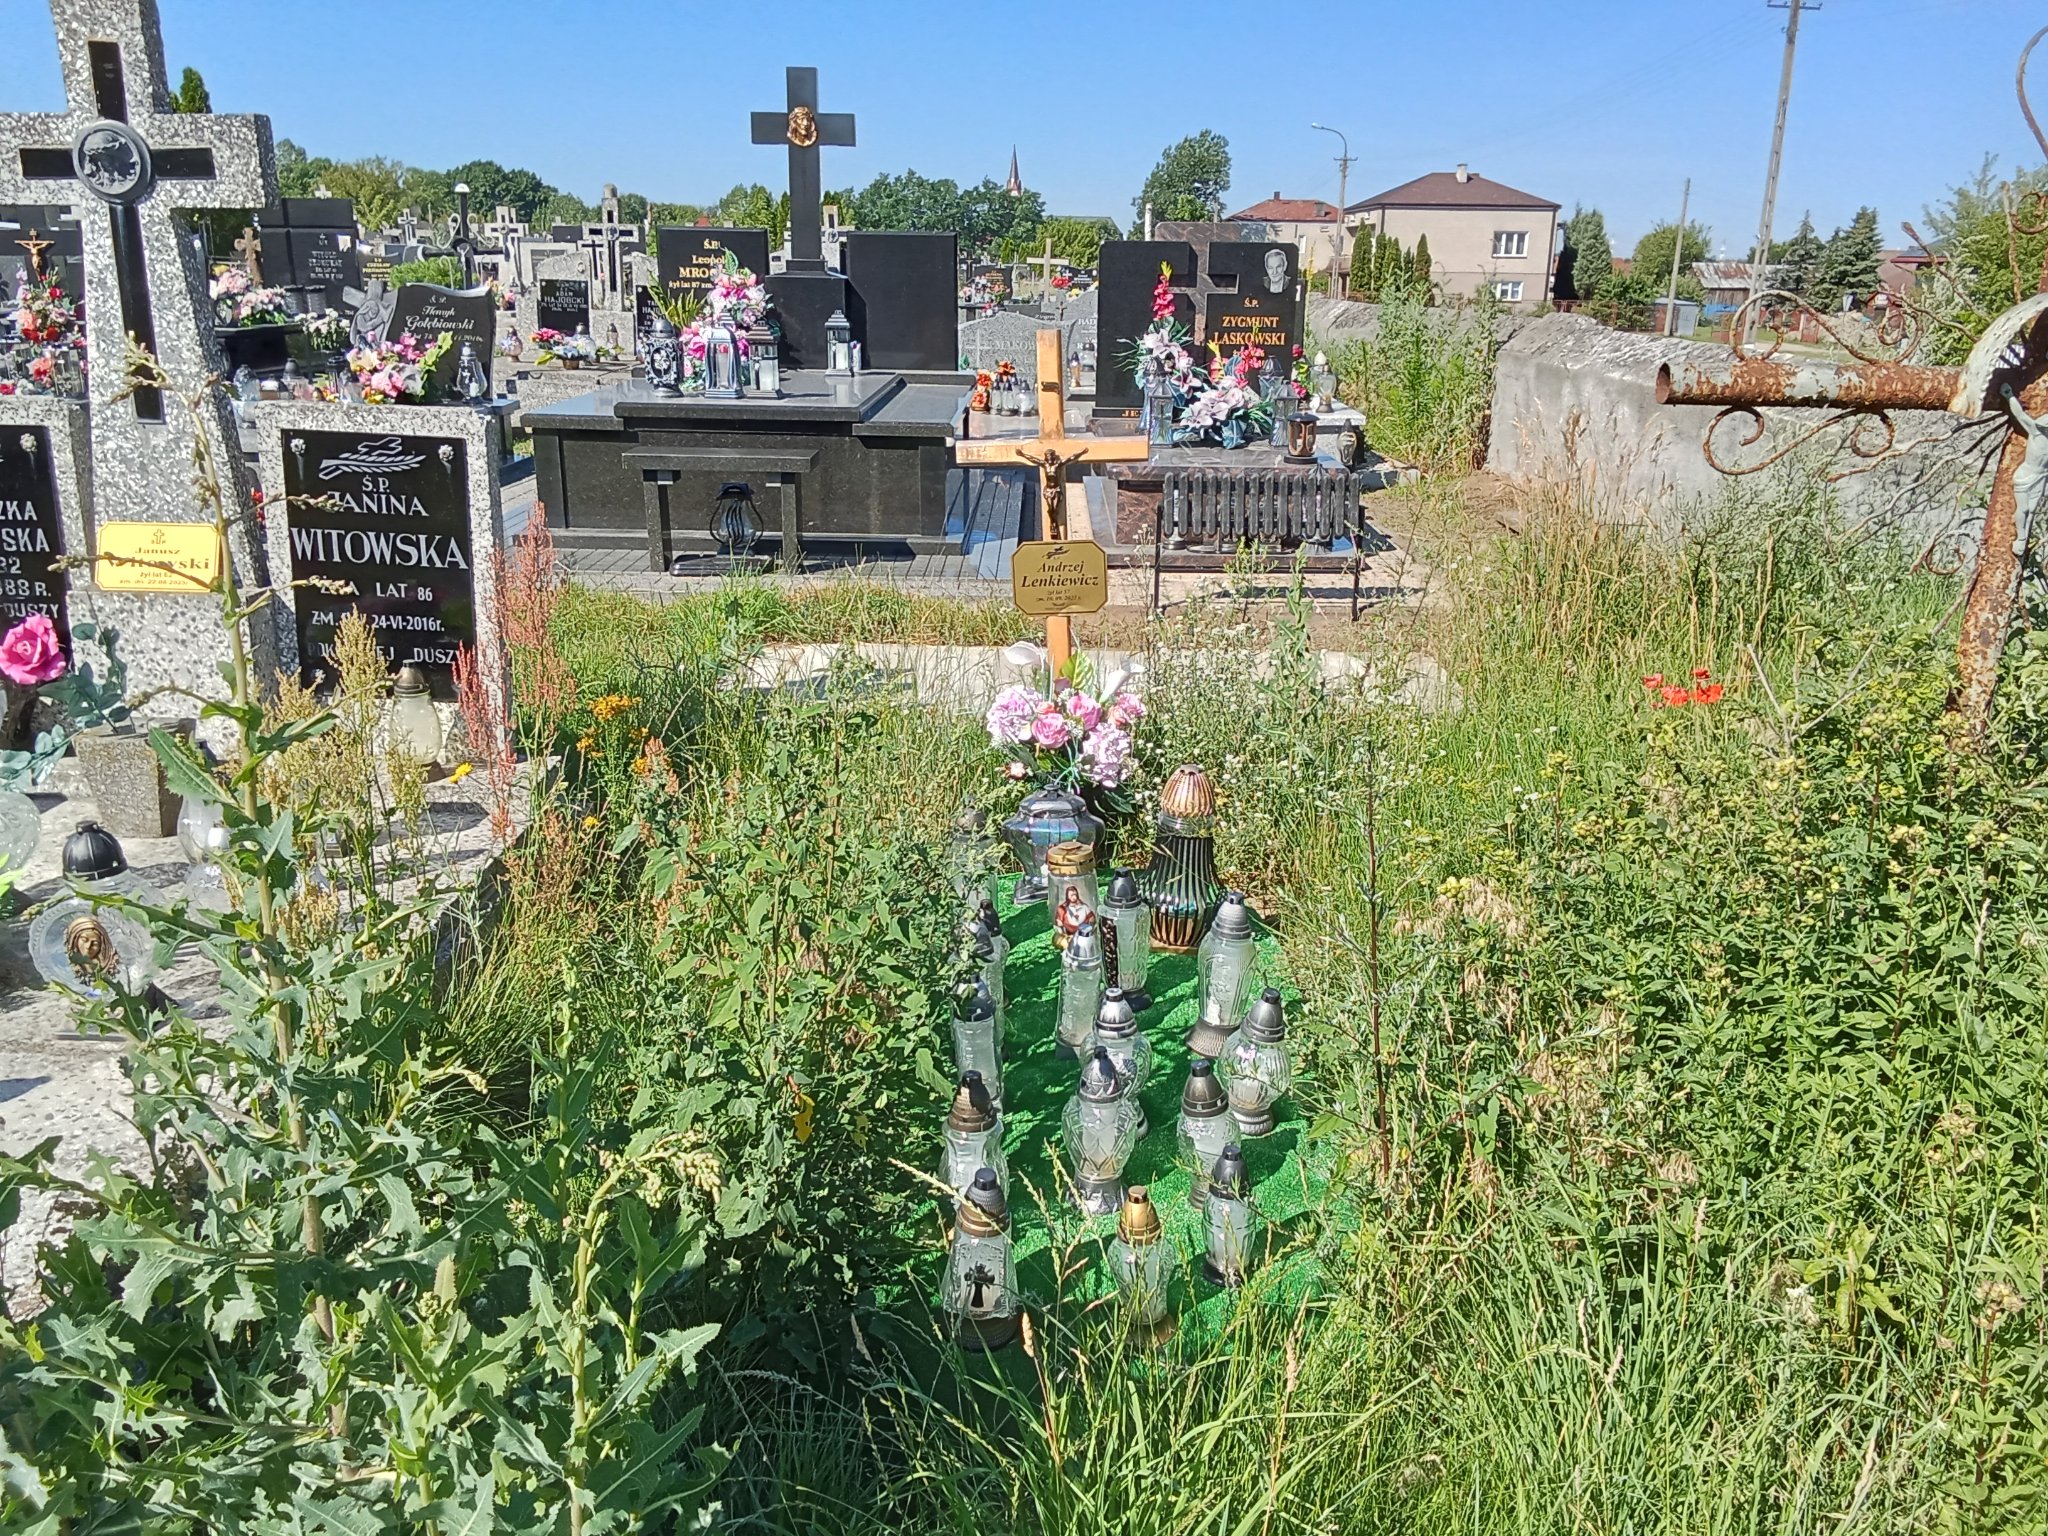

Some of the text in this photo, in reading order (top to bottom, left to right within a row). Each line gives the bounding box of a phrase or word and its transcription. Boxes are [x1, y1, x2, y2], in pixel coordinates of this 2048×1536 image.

[692, 254, 725, 266] Leopol
[1244, 297, 1260, 308] Ś.P.
[421, 305, 456, 318] Henryk
[405, 316, 475, 331] Gołębiowski
[1222, 316, 1280, 328] ZYGMUNT
[1214, 331, 1286, 346] LASKOWSKI
[362, 475, 390, 492] Ś.P.
[327, 491, 430, 517] JANINA
[135, 547, 181, 555] Janusz
[290, 527, 469, 570] WITOWSKA
[103, 553, 210, 570] itowski
[1037, 561, 1084, 574] Andrzej
[0, 579, 52, 597] 88 R.
[1021, 574, 1099, 588] Lenkiewicz
[375, 582, 408, 598] LAT
[417, 587, 433, 601] 86
[4, 603, 60, 619] DUSZY
[311, 611, 339, 626] ZM.
